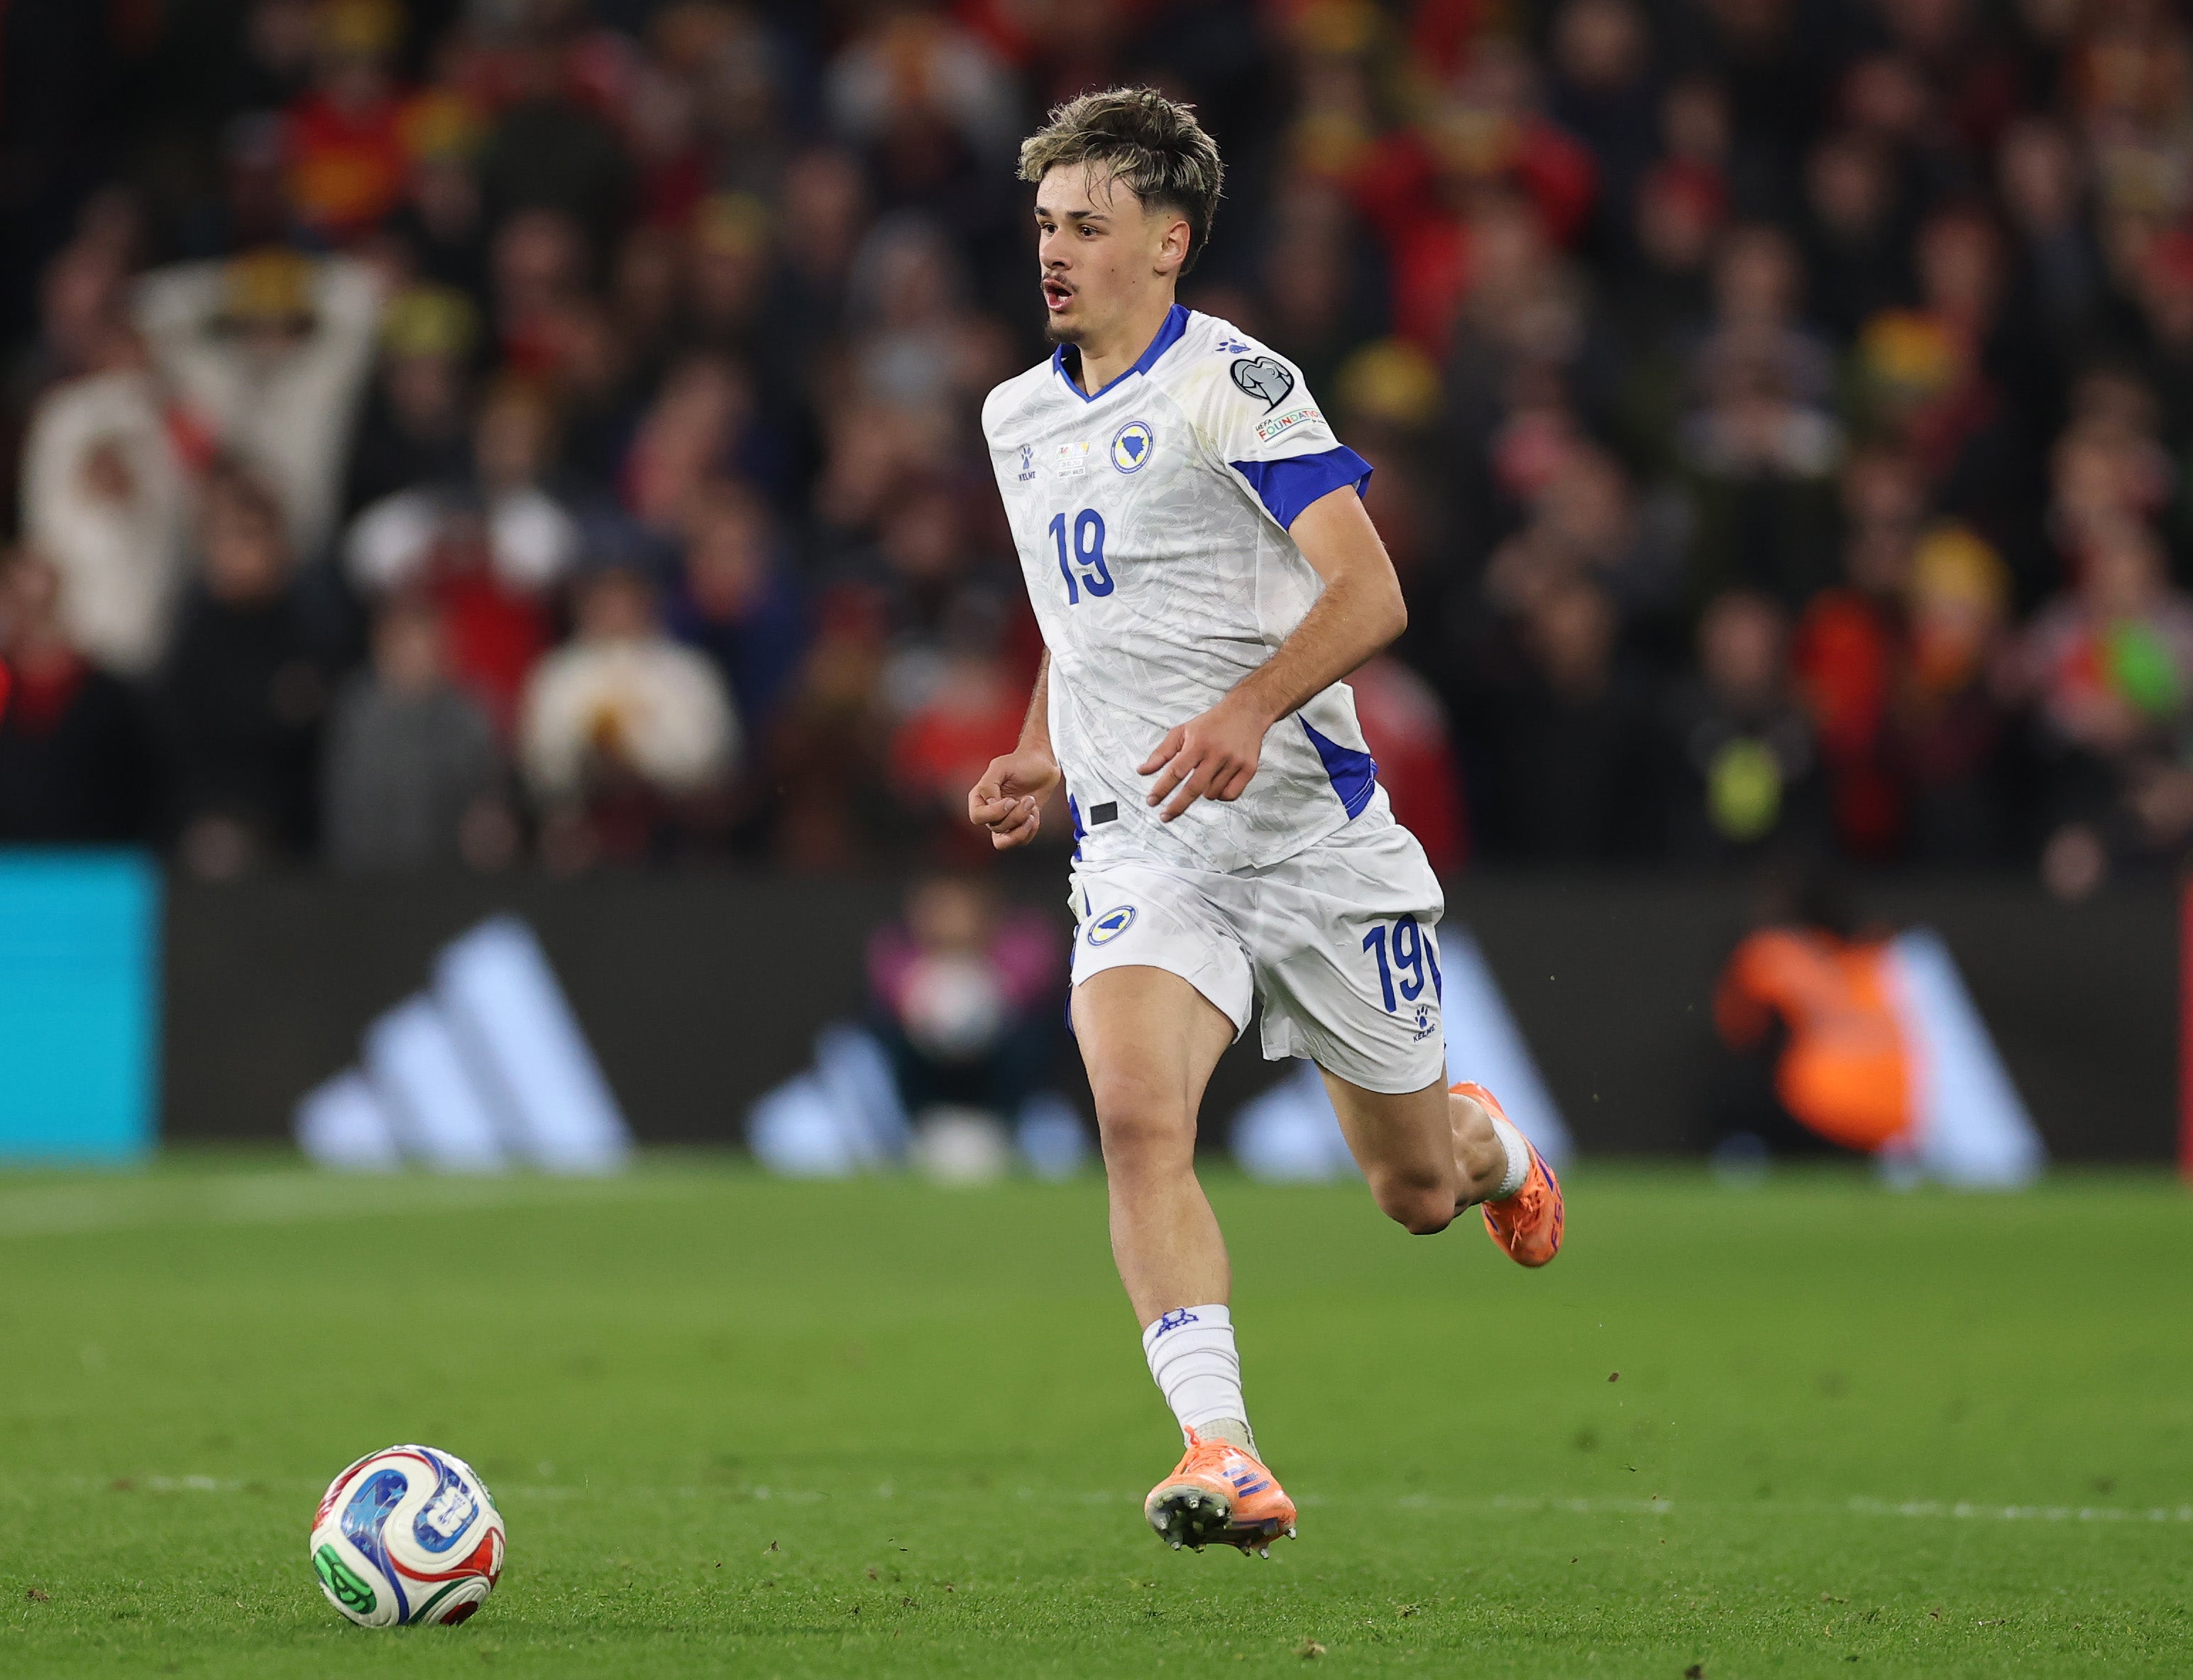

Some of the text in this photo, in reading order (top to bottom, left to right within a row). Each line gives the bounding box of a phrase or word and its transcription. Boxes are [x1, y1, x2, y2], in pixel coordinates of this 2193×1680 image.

[1255, 419, 1273, 432] UEFA
[1258, 410, 1322, 440] FOUNDATIO
[1018, 471, 1036, 482] KELME
[1048, 508, 1115, 605] 19
[1362, 913, 1425, 1014] 19
[1413, 1023, 1436, 1043] KELME
